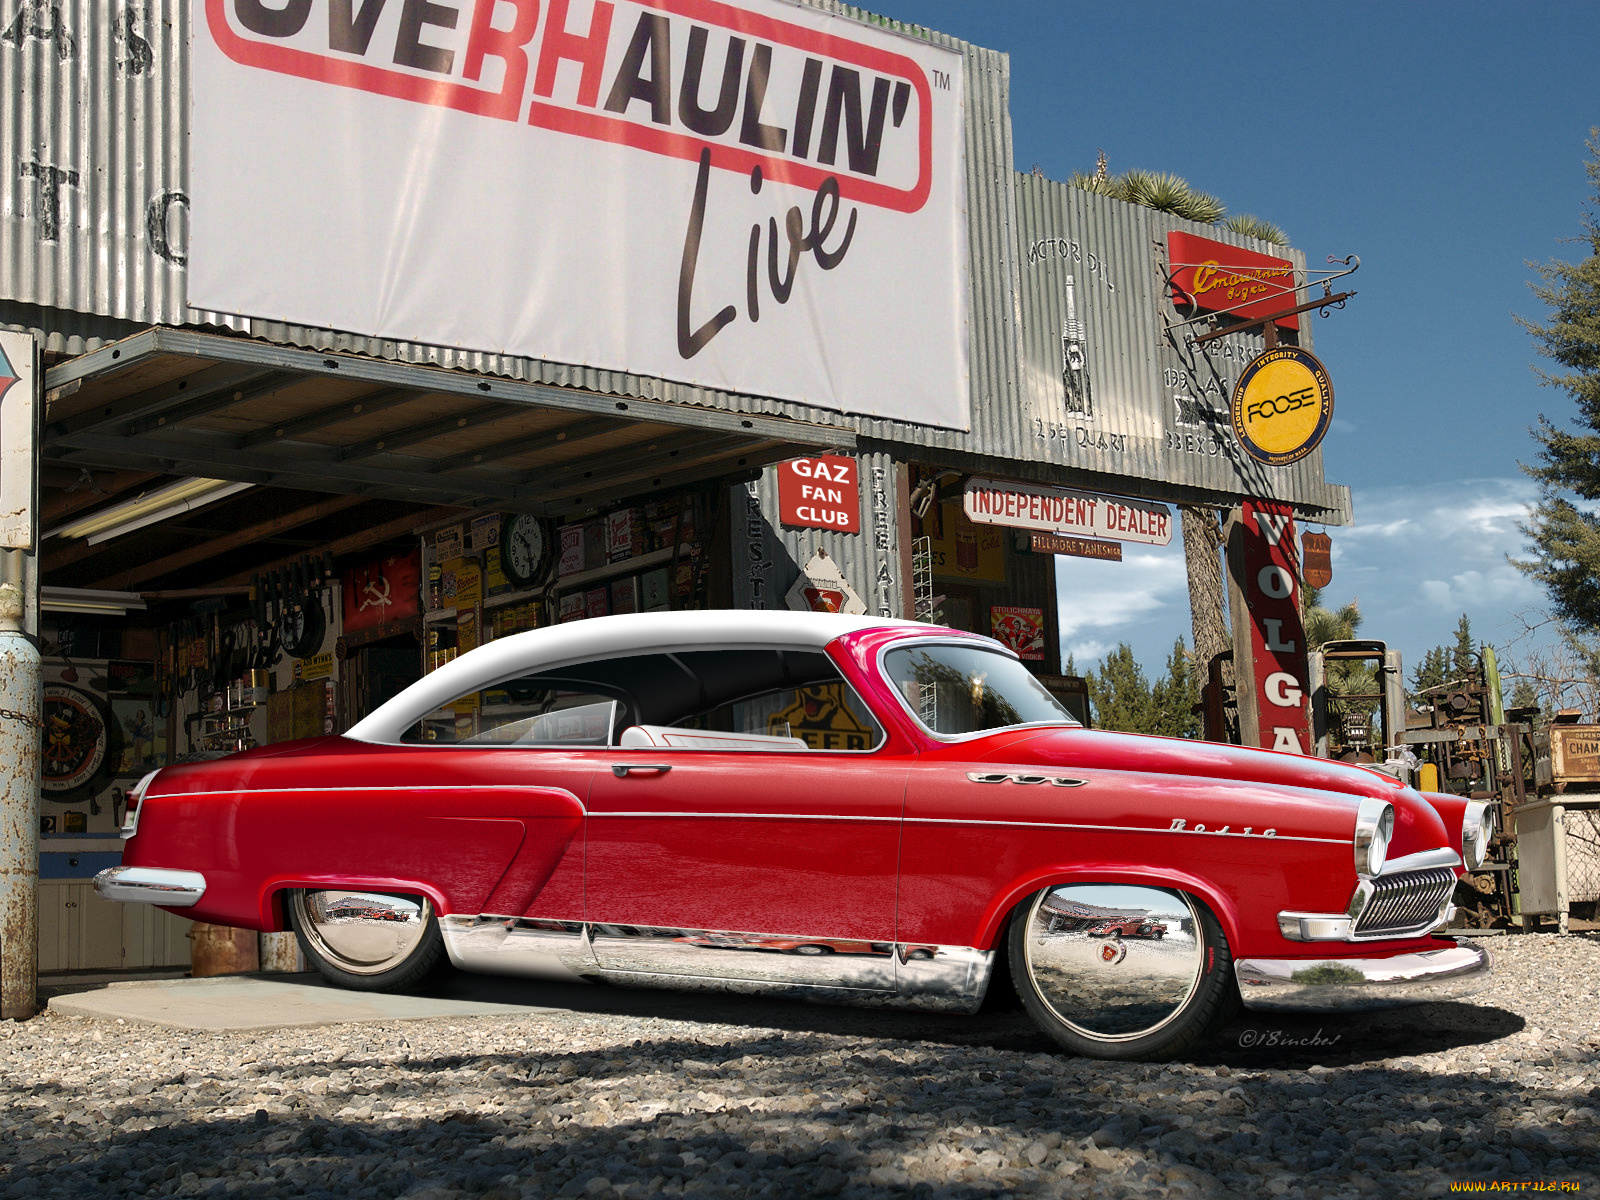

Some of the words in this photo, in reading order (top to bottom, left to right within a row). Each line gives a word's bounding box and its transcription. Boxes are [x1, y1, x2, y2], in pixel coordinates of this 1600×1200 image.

[676, 146, 857, 360] Live
[1257, 351, 1299, 368] INTEGRITY
[1248, 387, 1315, 423] FOOSE
[1315, 370, 1329, 415] QUALITY
[1234, 387, 1247, 438] LEADERSHIP
[1076, 426, 1126, 453] QUART
[791, 459, 849, 484] GAZ
[802, 485, 842, 504] FAN
[796, 506, 849, 526] CLUB
[871, 467, 889, 552] FREE
[972, 486, 1097, 528] INDEPENDENT
[1106, 503, 1167, 537] DEALER
[982, 535, 1000, 551] Cold
[1032, 536, 1076, 552] FILLMORE
[1079, 541, 1108, 556] TANKS
[993, 606, 1041, 616] STOLICHNAYA
[1252, 511, 1304, 755] VOLGA
[1021, 653, 1042, 661] VODKA
[1569, 742, 1599, 754] CHAM
